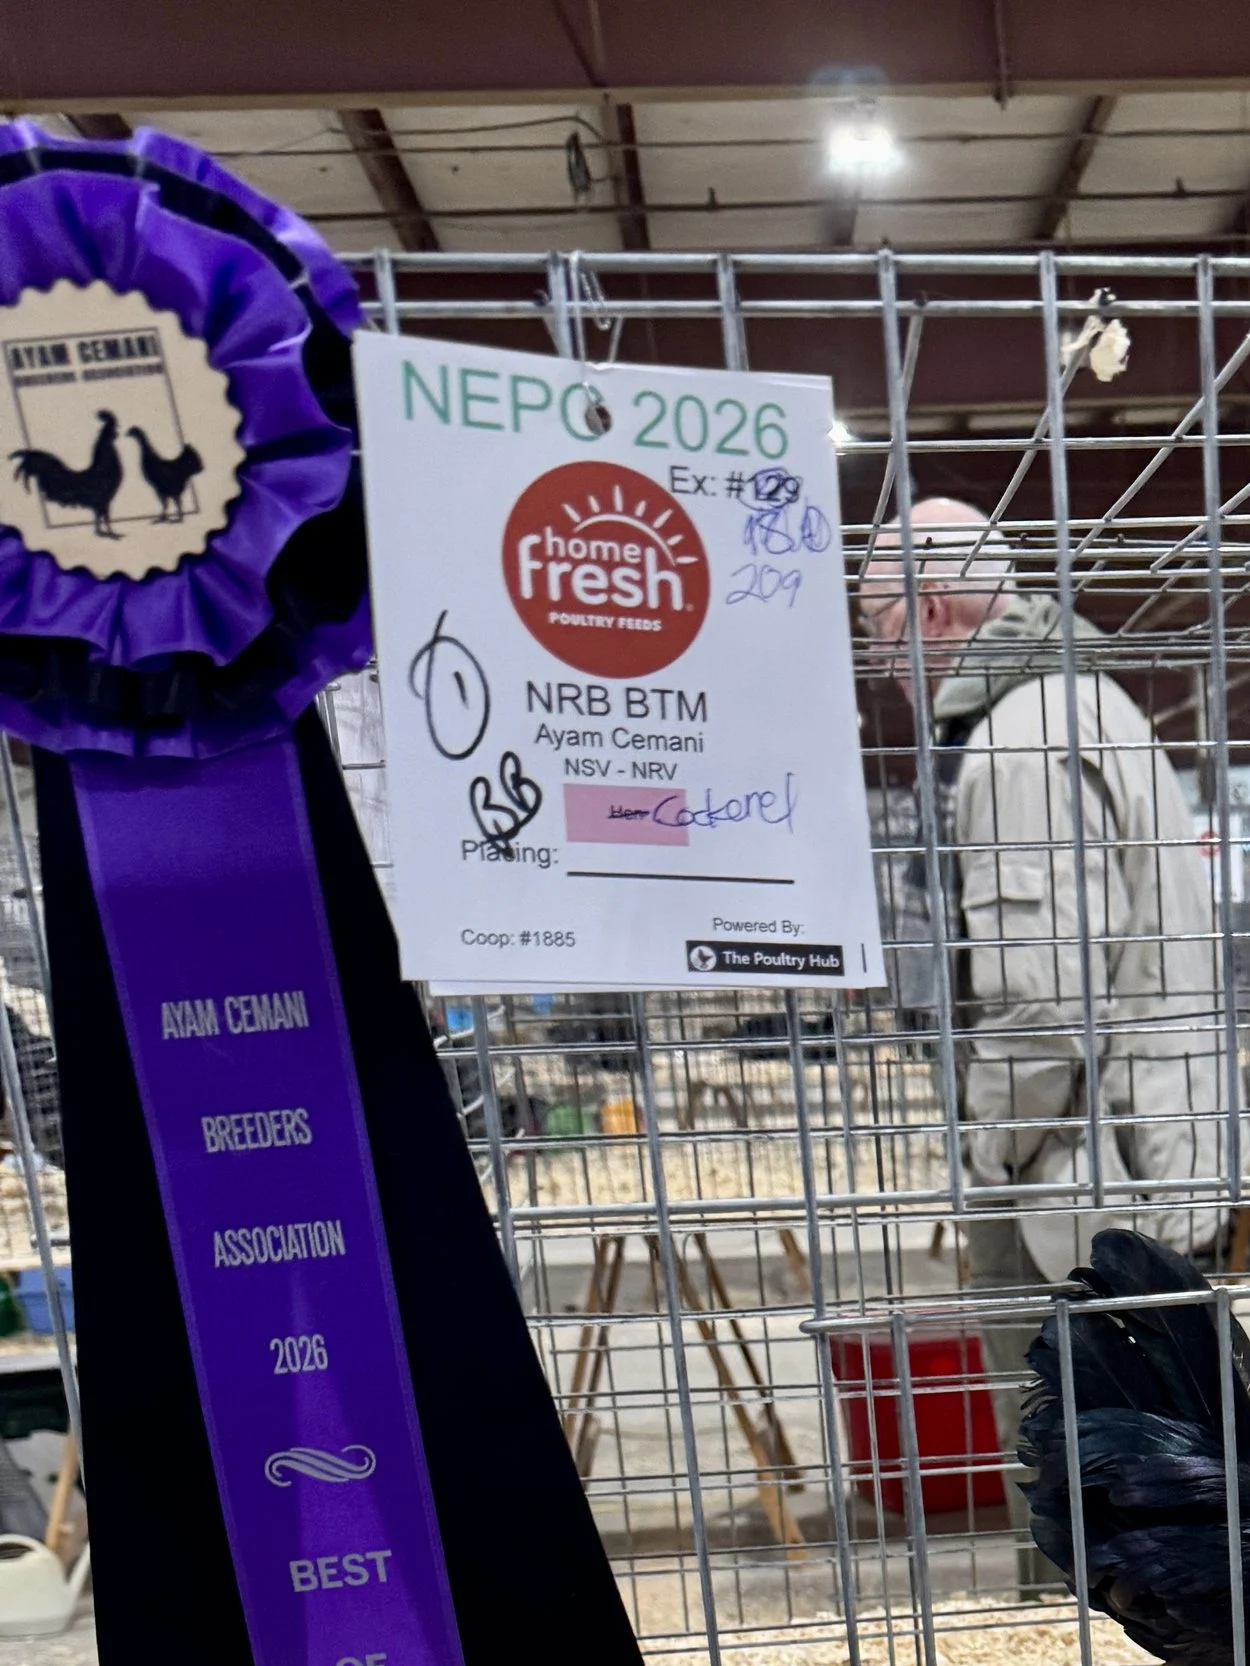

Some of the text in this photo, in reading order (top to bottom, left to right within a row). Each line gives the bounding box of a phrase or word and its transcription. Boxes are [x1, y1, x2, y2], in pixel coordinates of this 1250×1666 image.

[632, 390, 788, 459] 2026
[669, 465, 717, 497] Ex:
[544, 526, 641, 563] home
[518, 534, 683, 611] fresh
[725, 563, 802, 608] 209
[548, 611, 663, 632] POULTRY FEEDS
[526, 680, 708, 723] NRB BTM
[534, 723, 704, 753] Ayam Cemani
[564, 757, 611, 777] NSV
[632, 761, 678, 780] NRV
[461, 929, 576, 948] Coop: #1885
[713, 917, 805, 937] Powered By:
[722, 950, 840, 971] The Poultry Hub
[161, 989, 309, 1040] AYAM CEMANI
[202, 1108, 312, 1153] BREEDERS
[213, 1220, 346, 1268] ASSOCIATION
[270, 1333, 328, 1375] 2026
[289, 1549, 392, 1593] BEST
